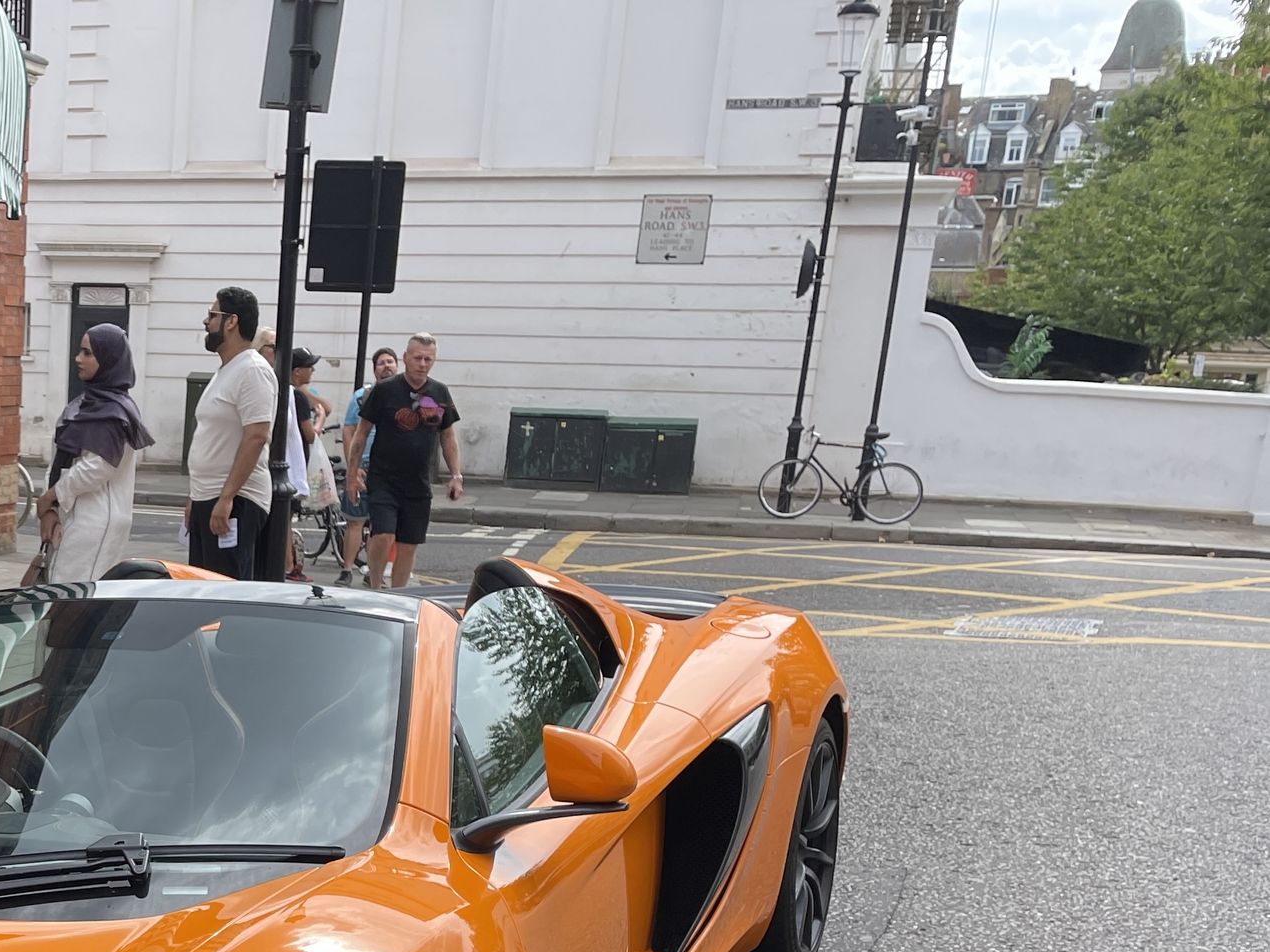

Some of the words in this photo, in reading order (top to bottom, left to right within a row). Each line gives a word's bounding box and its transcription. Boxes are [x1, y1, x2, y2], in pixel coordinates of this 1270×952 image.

[727, 98, 756, 109] HANS
[756, 98, 786, 108] ROAD
[659, 211, 692, 220] HANS
[644, 221, 675, 231] ROAD
